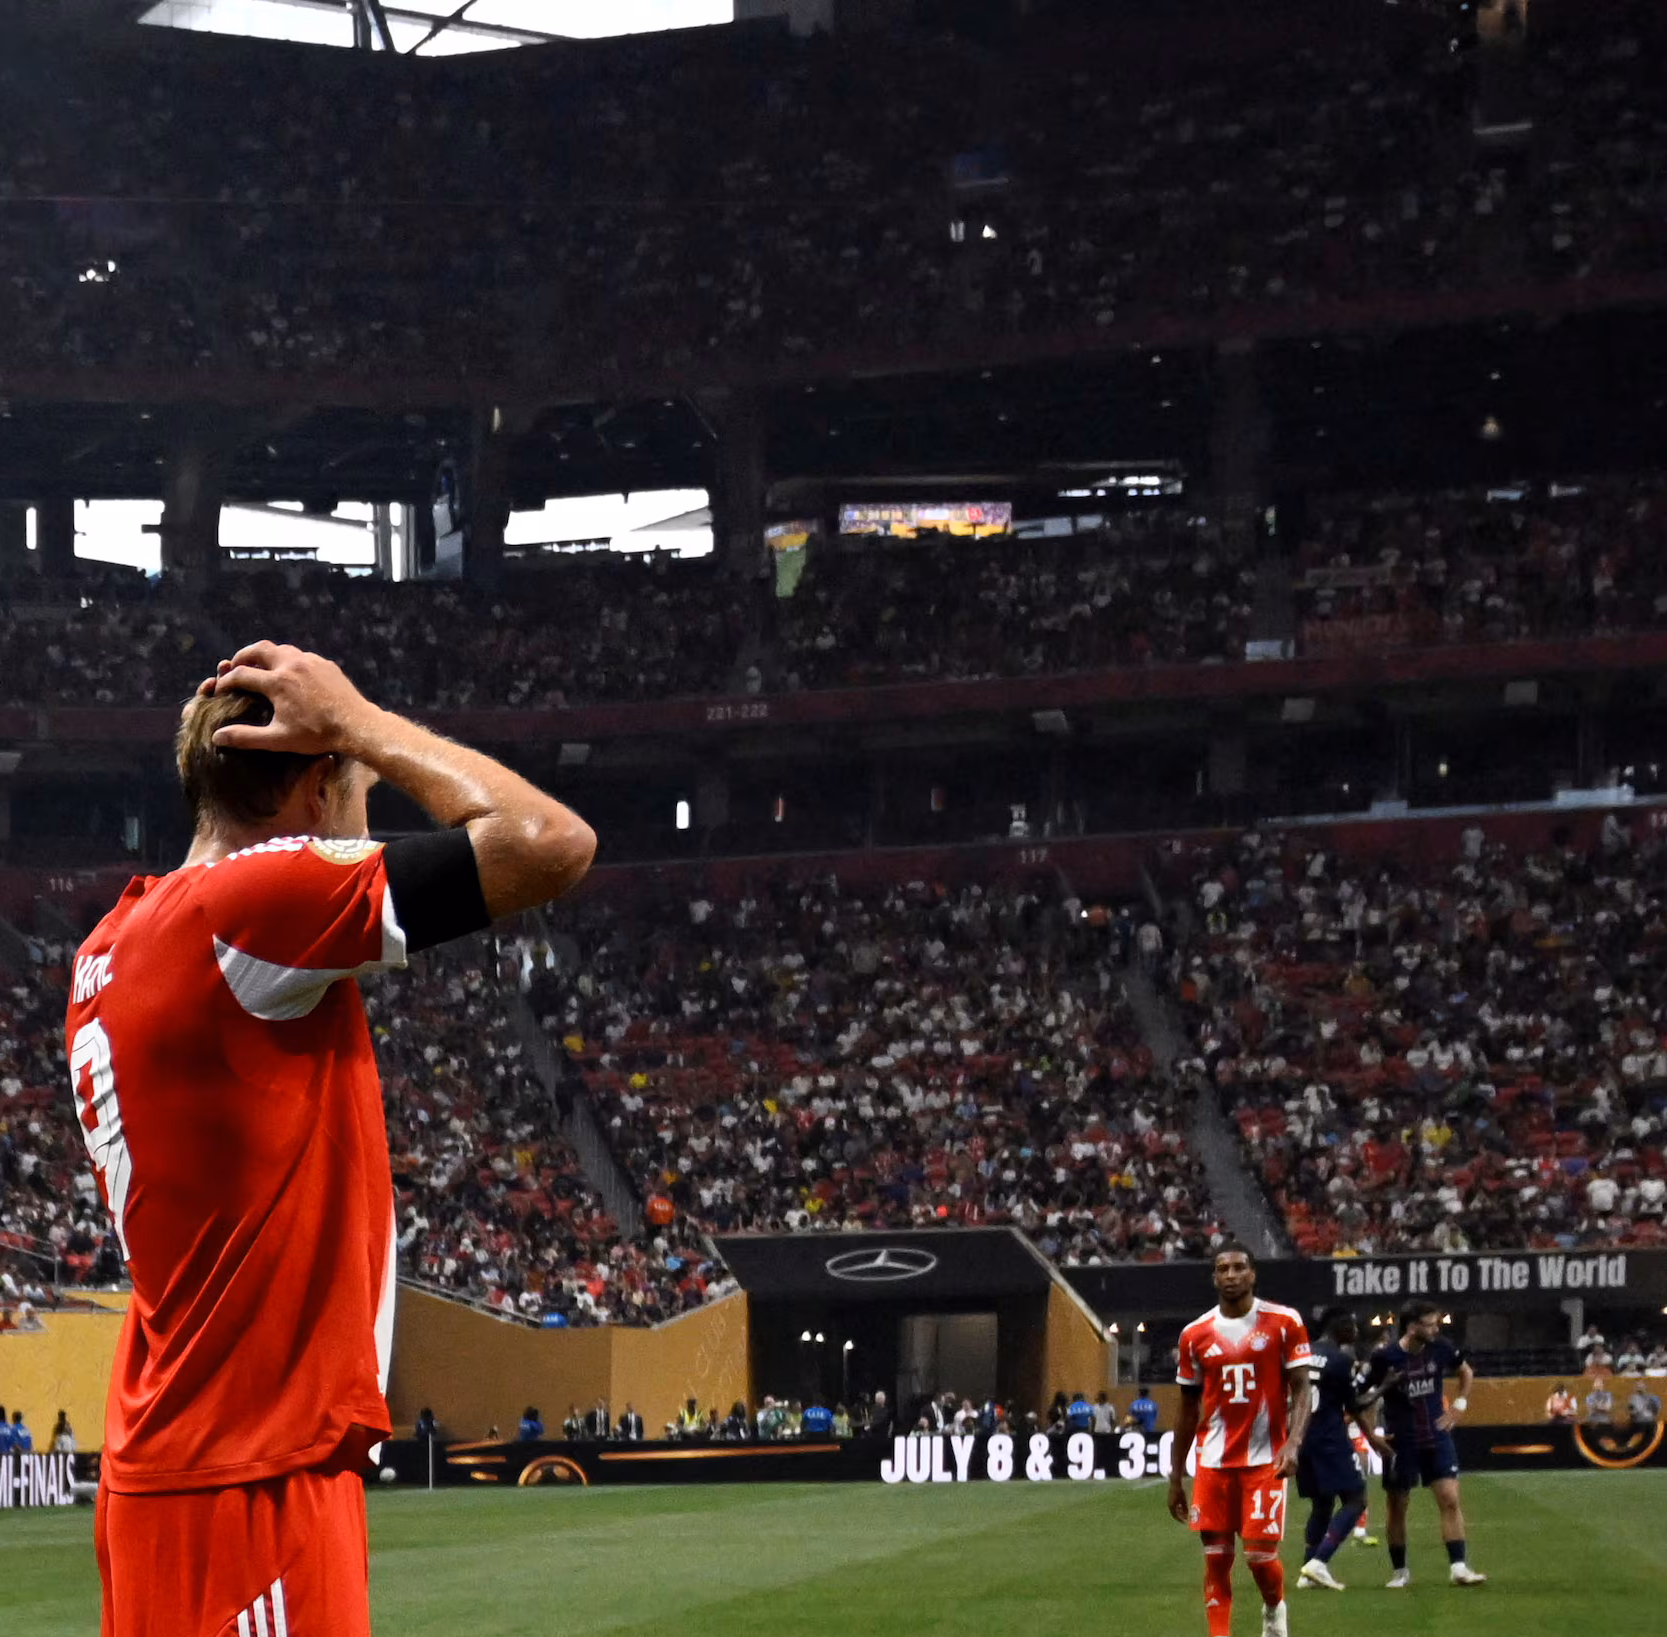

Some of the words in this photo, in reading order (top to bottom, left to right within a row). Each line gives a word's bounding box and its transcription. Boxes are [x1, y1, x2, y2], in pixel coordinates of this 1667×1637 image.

[1332, 1261, 1401, 1296] Take
[1408, 1259, 1429, 1293] It
[1436, 1258, 1469, 1293] To
[1477, 1256, 1530, 1291] The
[1538, 1254, 1627, 1289] World
[879, 1434, 976, 1484] JULY
[986, 1433, 1014, 1482] 8
[1024, 1432, 1054, 1482] &
[1067, 1432, 1106, 1481] 9.
[1250, 1489, 1284, 1521] 17
